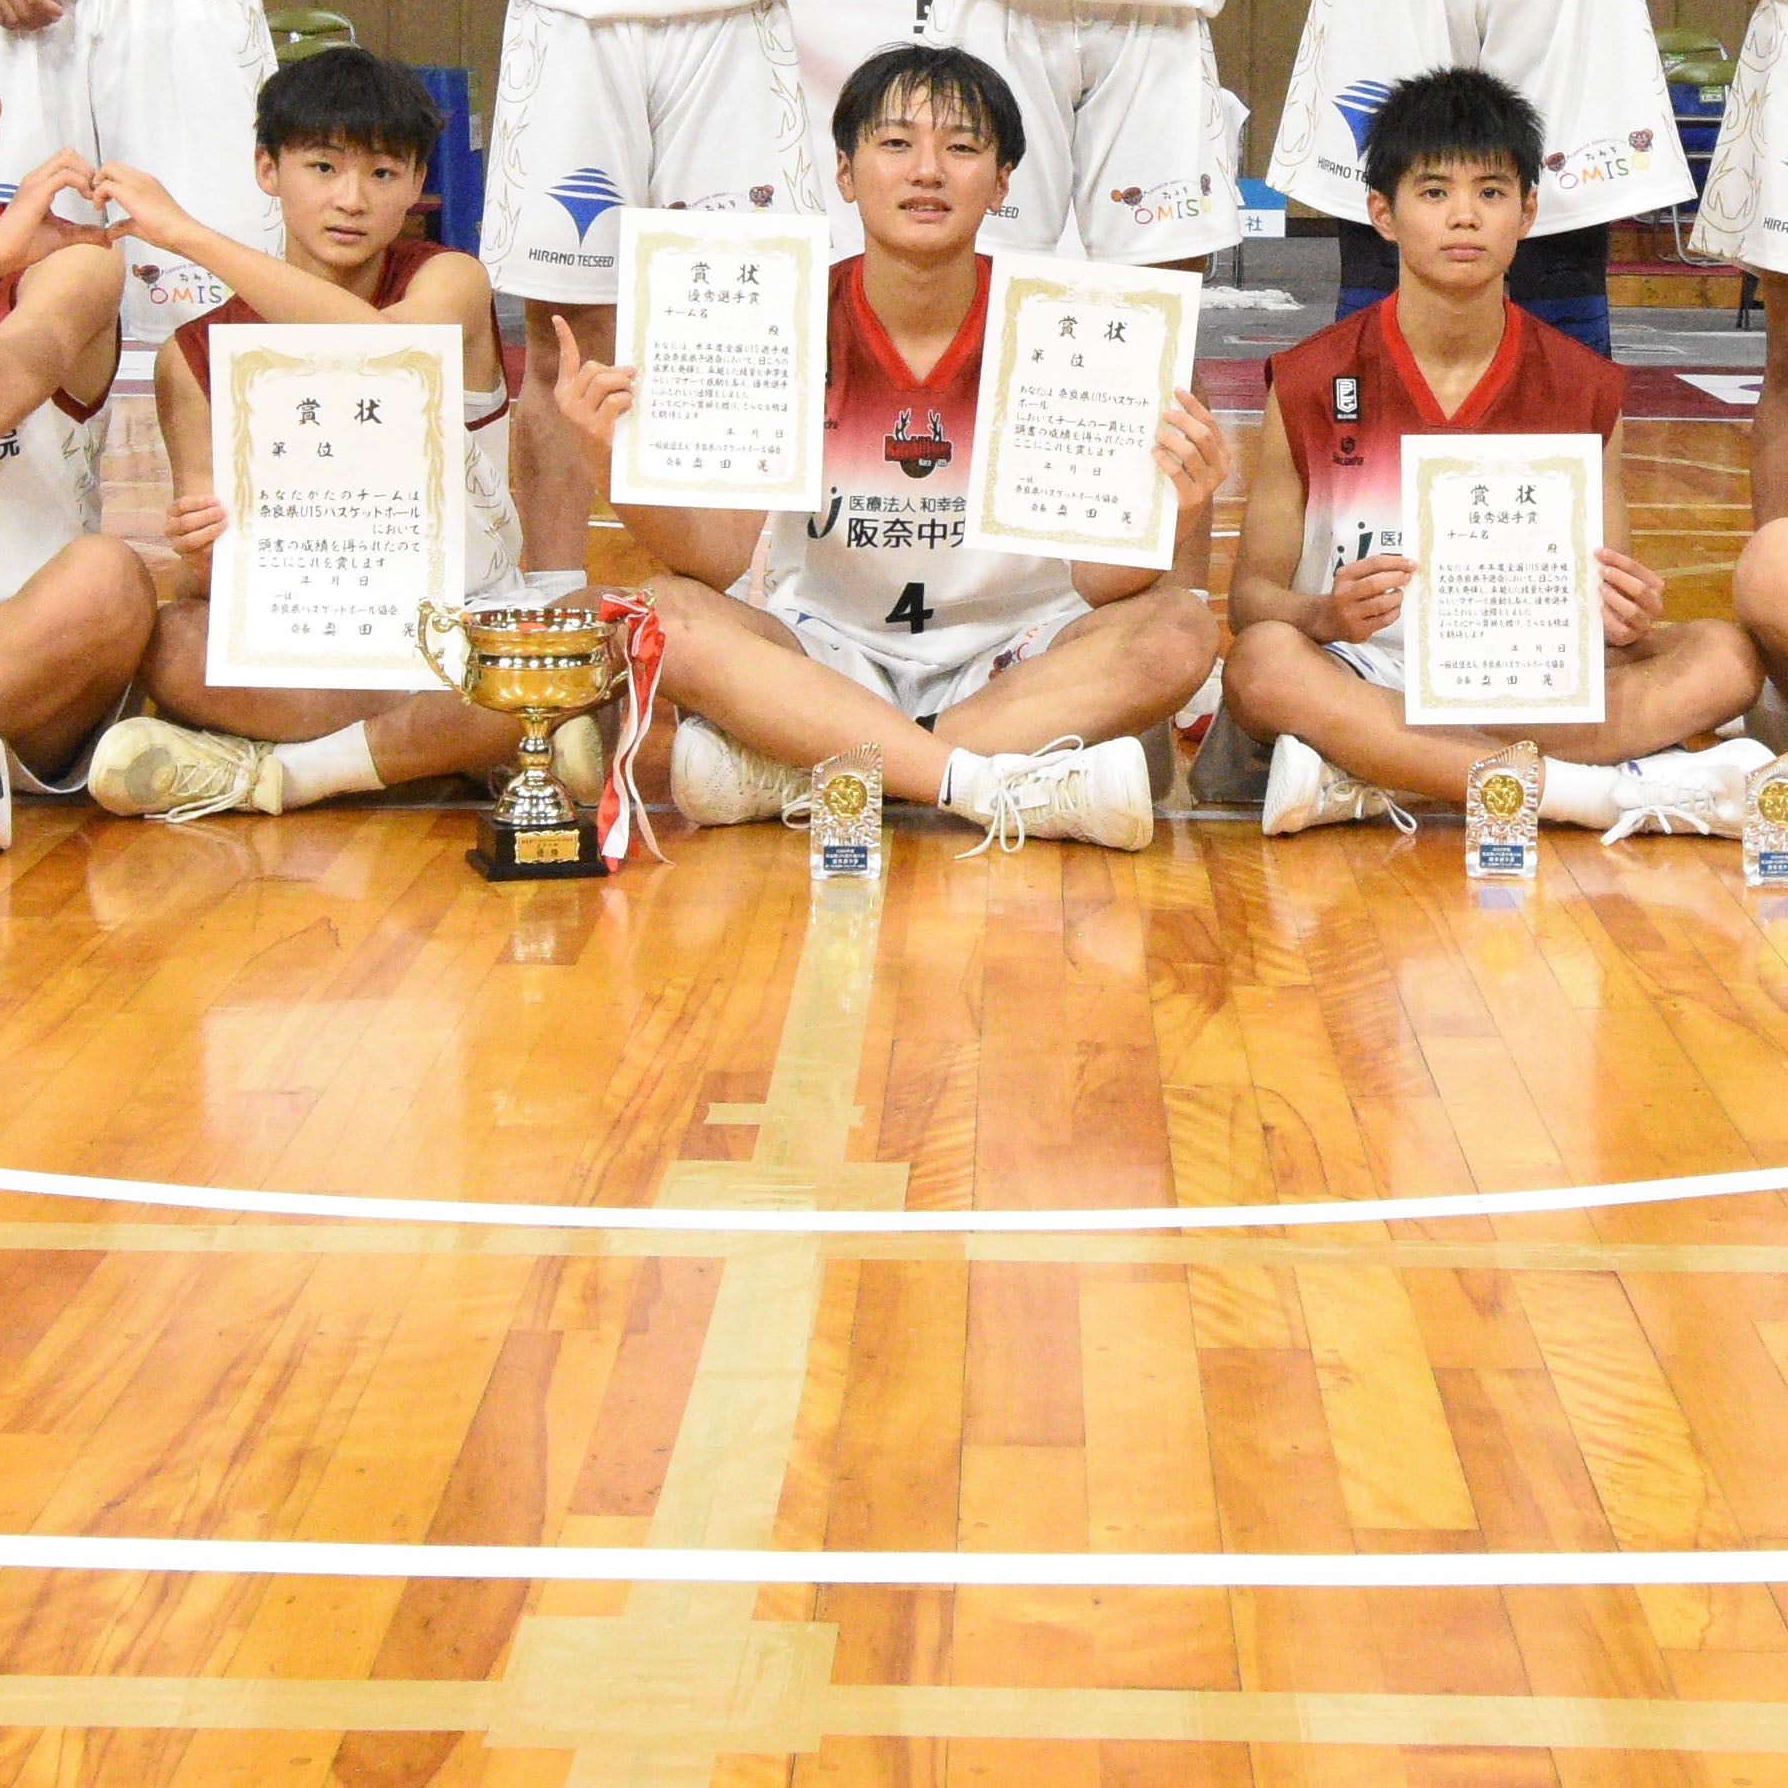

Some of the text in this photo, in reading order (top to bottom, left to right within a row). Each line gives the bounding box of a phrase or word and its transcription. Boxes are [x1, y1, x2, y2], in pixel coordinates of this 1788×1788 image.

[1317, 155, 1352, 180] HIRANO
[528, 248, 614, 269] HIRANO TECSEED
[688, 290, 760, 304] 優秀選手賞
[297, 398, 382, 425] 賞状
[849, 495, 916, 513] 医療法人
[1469, 512, 1539, 524] 優秀選手賞
[373, 523, 420, 535] において
[885, 582, 934, 634] 4
